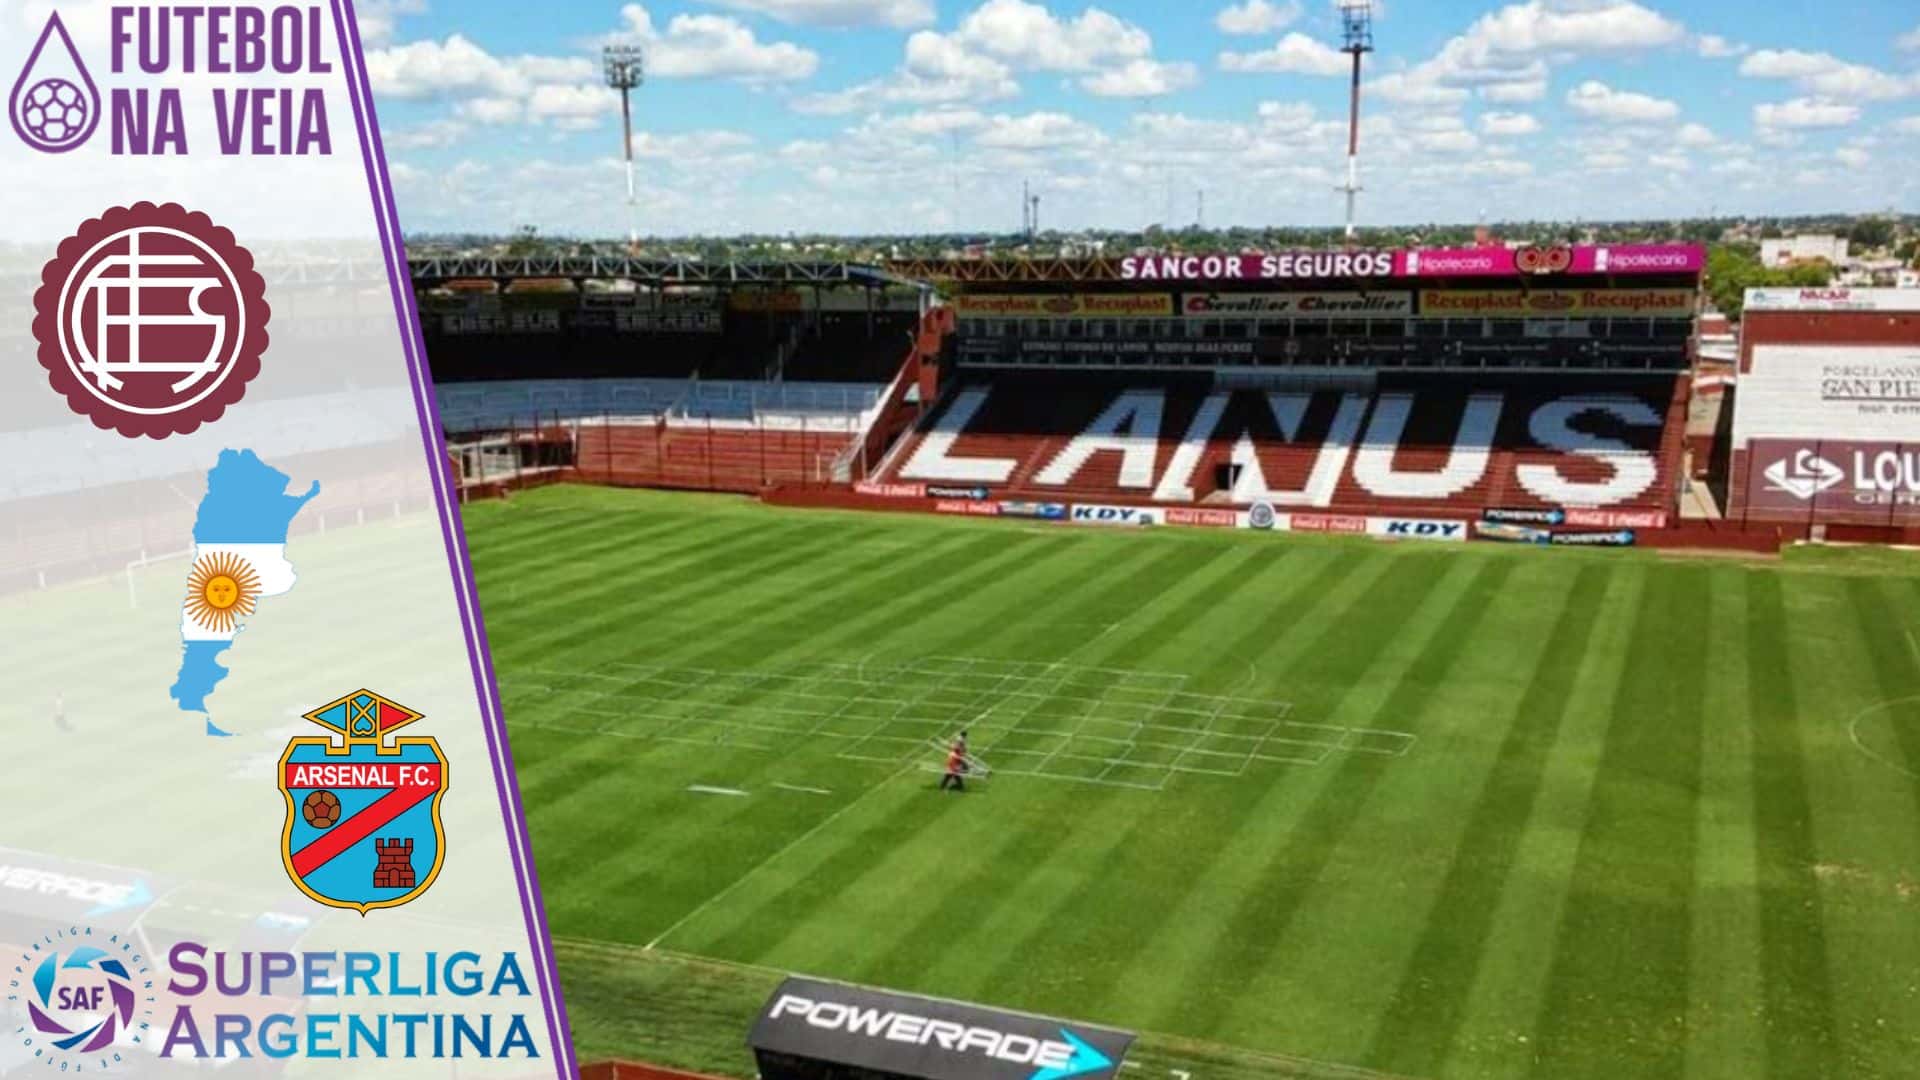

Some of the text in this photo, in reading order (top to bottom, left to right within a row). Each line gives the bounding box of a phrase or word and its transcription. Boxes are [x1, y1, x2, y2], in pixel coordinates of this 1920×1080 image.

[1121, 253, 1391, 279] SANCOR SEGUROS
[1608, 252, 1687, 268] Hipotecario
[897, 385, 1663, 507] LANUS
[1074, 507, 1137, 520] KDY
[1386, 520, 1461, 537] KDY
[768, 993, 1078, 1071] POWERADE
